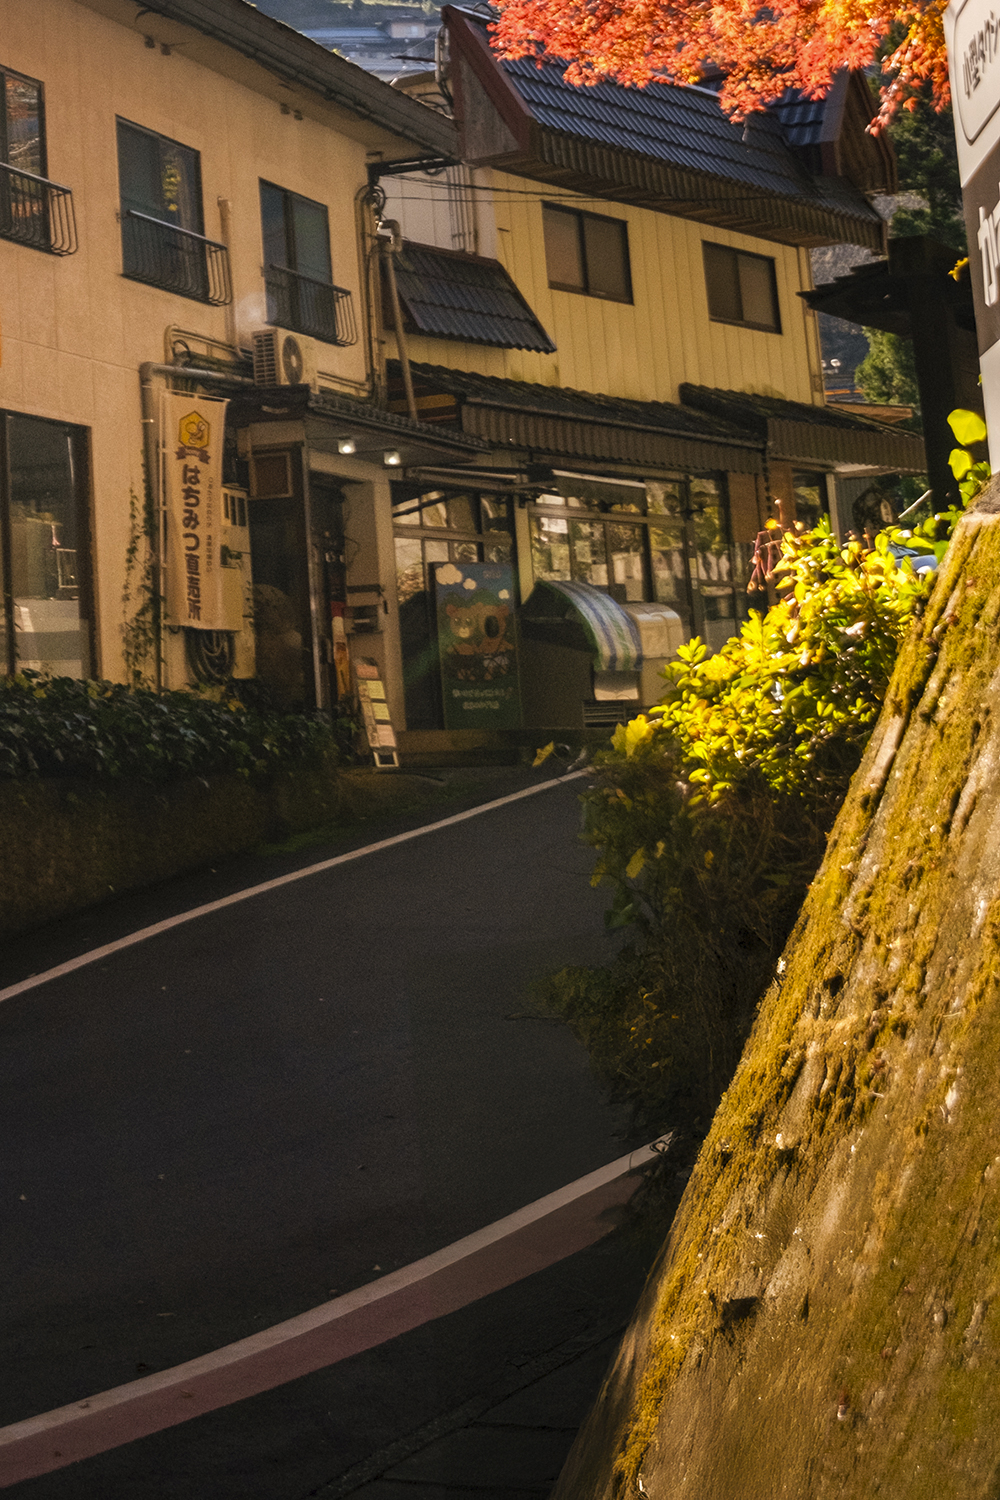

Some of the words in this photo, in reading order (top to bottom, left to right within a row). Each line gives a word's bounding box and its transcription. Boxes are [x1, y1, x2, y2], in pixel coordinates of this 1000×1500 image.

[962, 10, 1000, 99] 小型タクシ
[181, 463, 201, 621] はちみつ直売所
